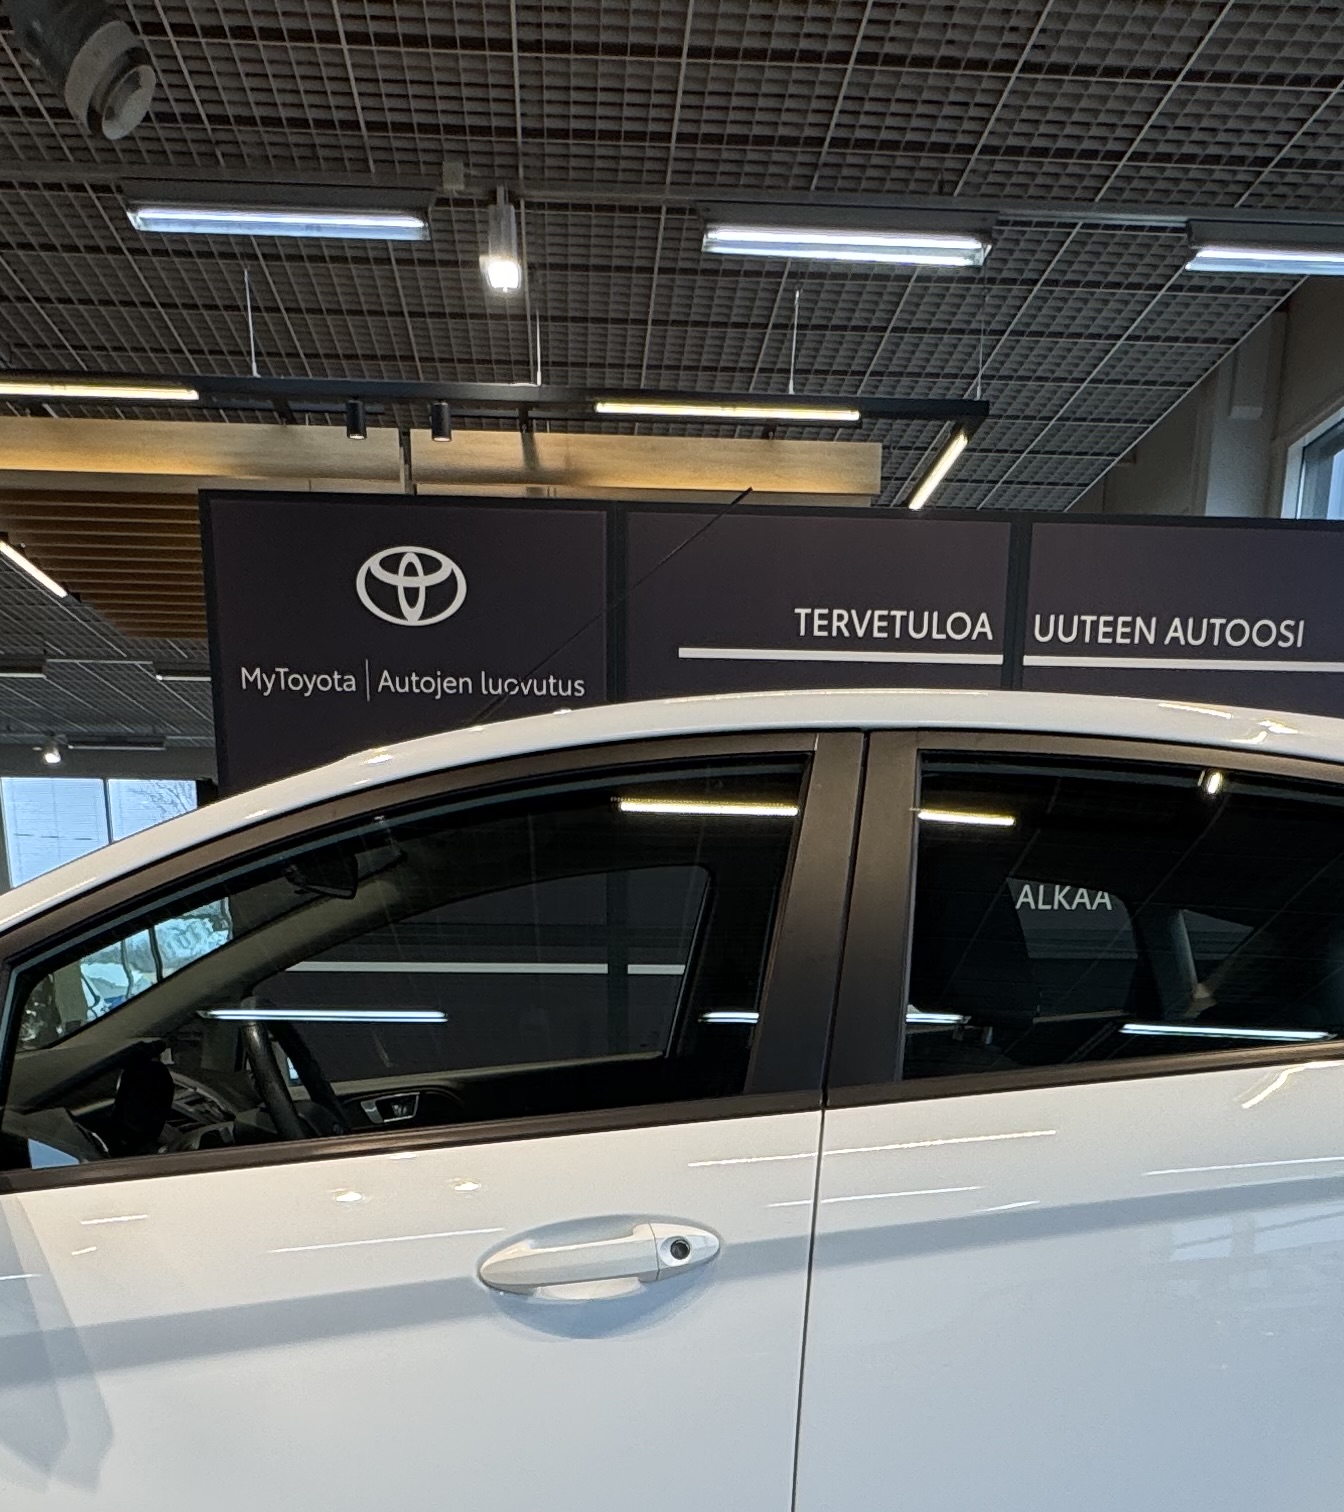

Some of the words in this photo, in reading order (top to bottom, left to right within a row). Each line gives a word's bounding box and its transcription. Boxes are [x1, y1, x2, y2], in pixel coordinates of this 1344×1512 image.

[794, 607, 994, 641] TERVETULOA
[1033, 613, 1157, 645] UUTEEN
[1163, 616, 1305, 648] AUTOOSI
[240, 666, 357, 697] MyToyota
[377, 669, 473, 699] Autojen
[481, 670, 586, 697] luovutus
[1015, 884, 1113, 911] ALKAA
